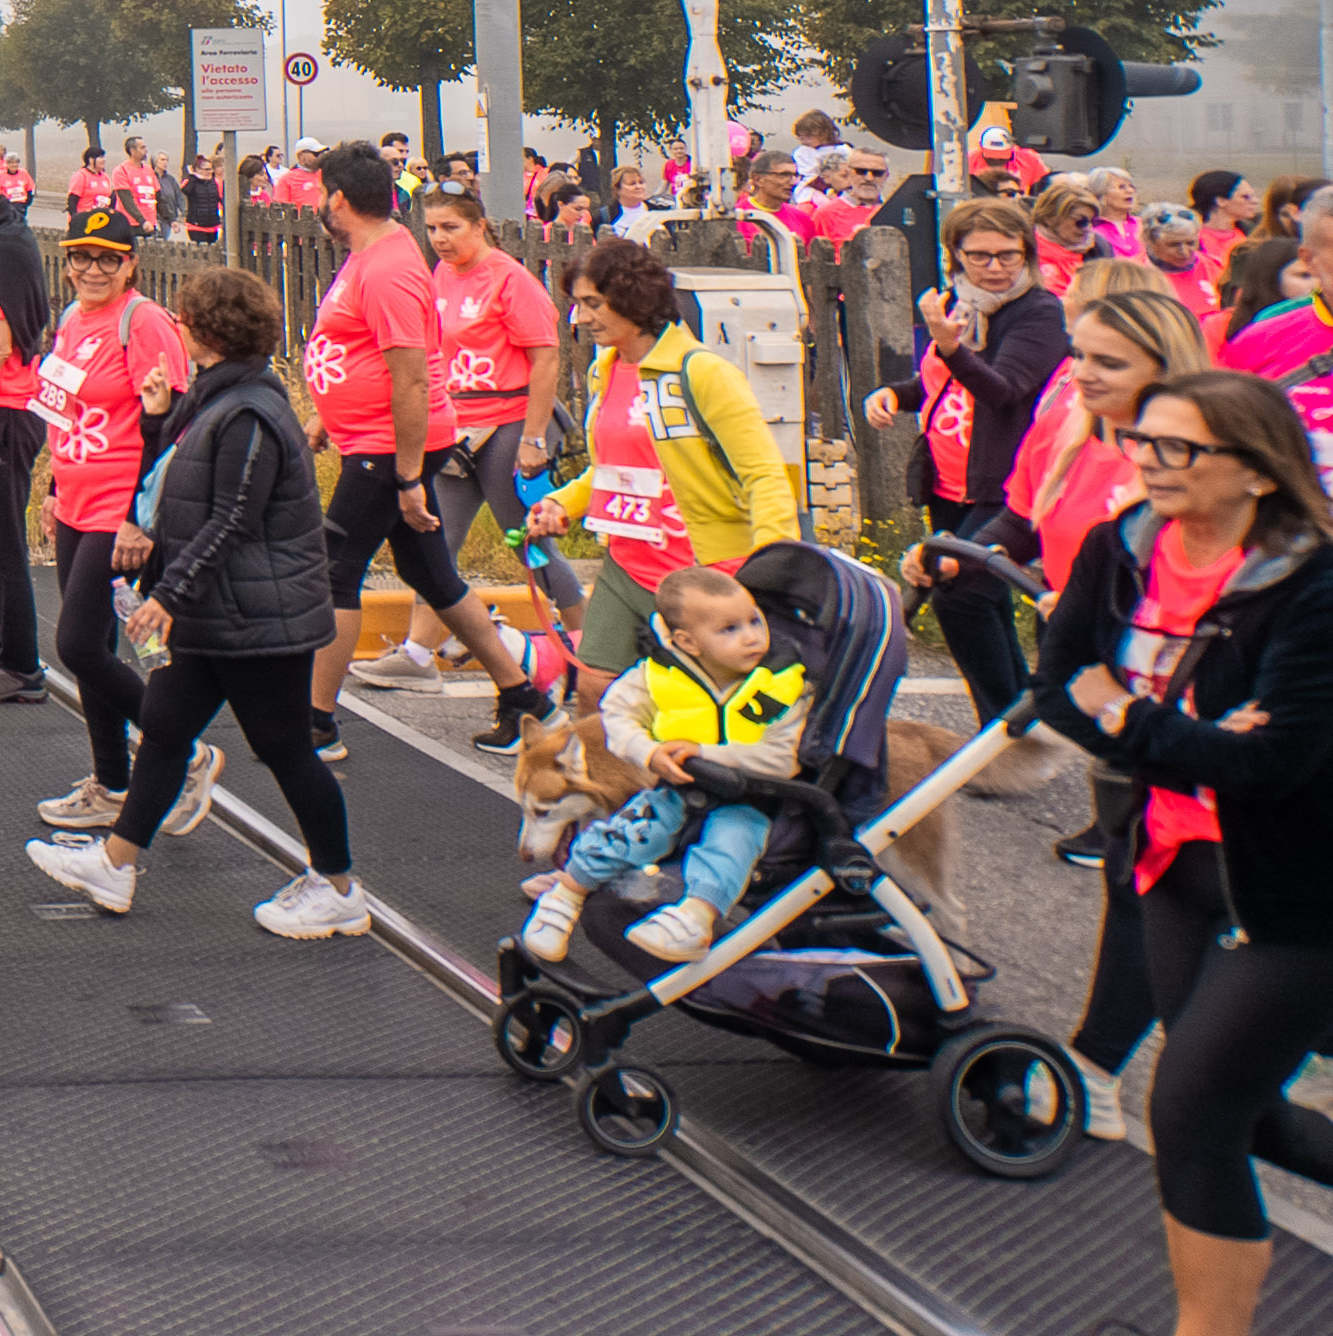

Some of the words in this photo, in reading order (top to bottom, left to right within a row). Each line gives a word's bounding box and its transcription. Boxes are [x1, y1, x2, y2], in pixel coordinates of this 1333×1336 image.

[201, 63, 248, 74] Vietato
[290, 61, 313, 77] 40
[202, 75, 259, 86] l'accesso
[39, 380, 67, 412] 289
[604, 493, 652, 523] 473
